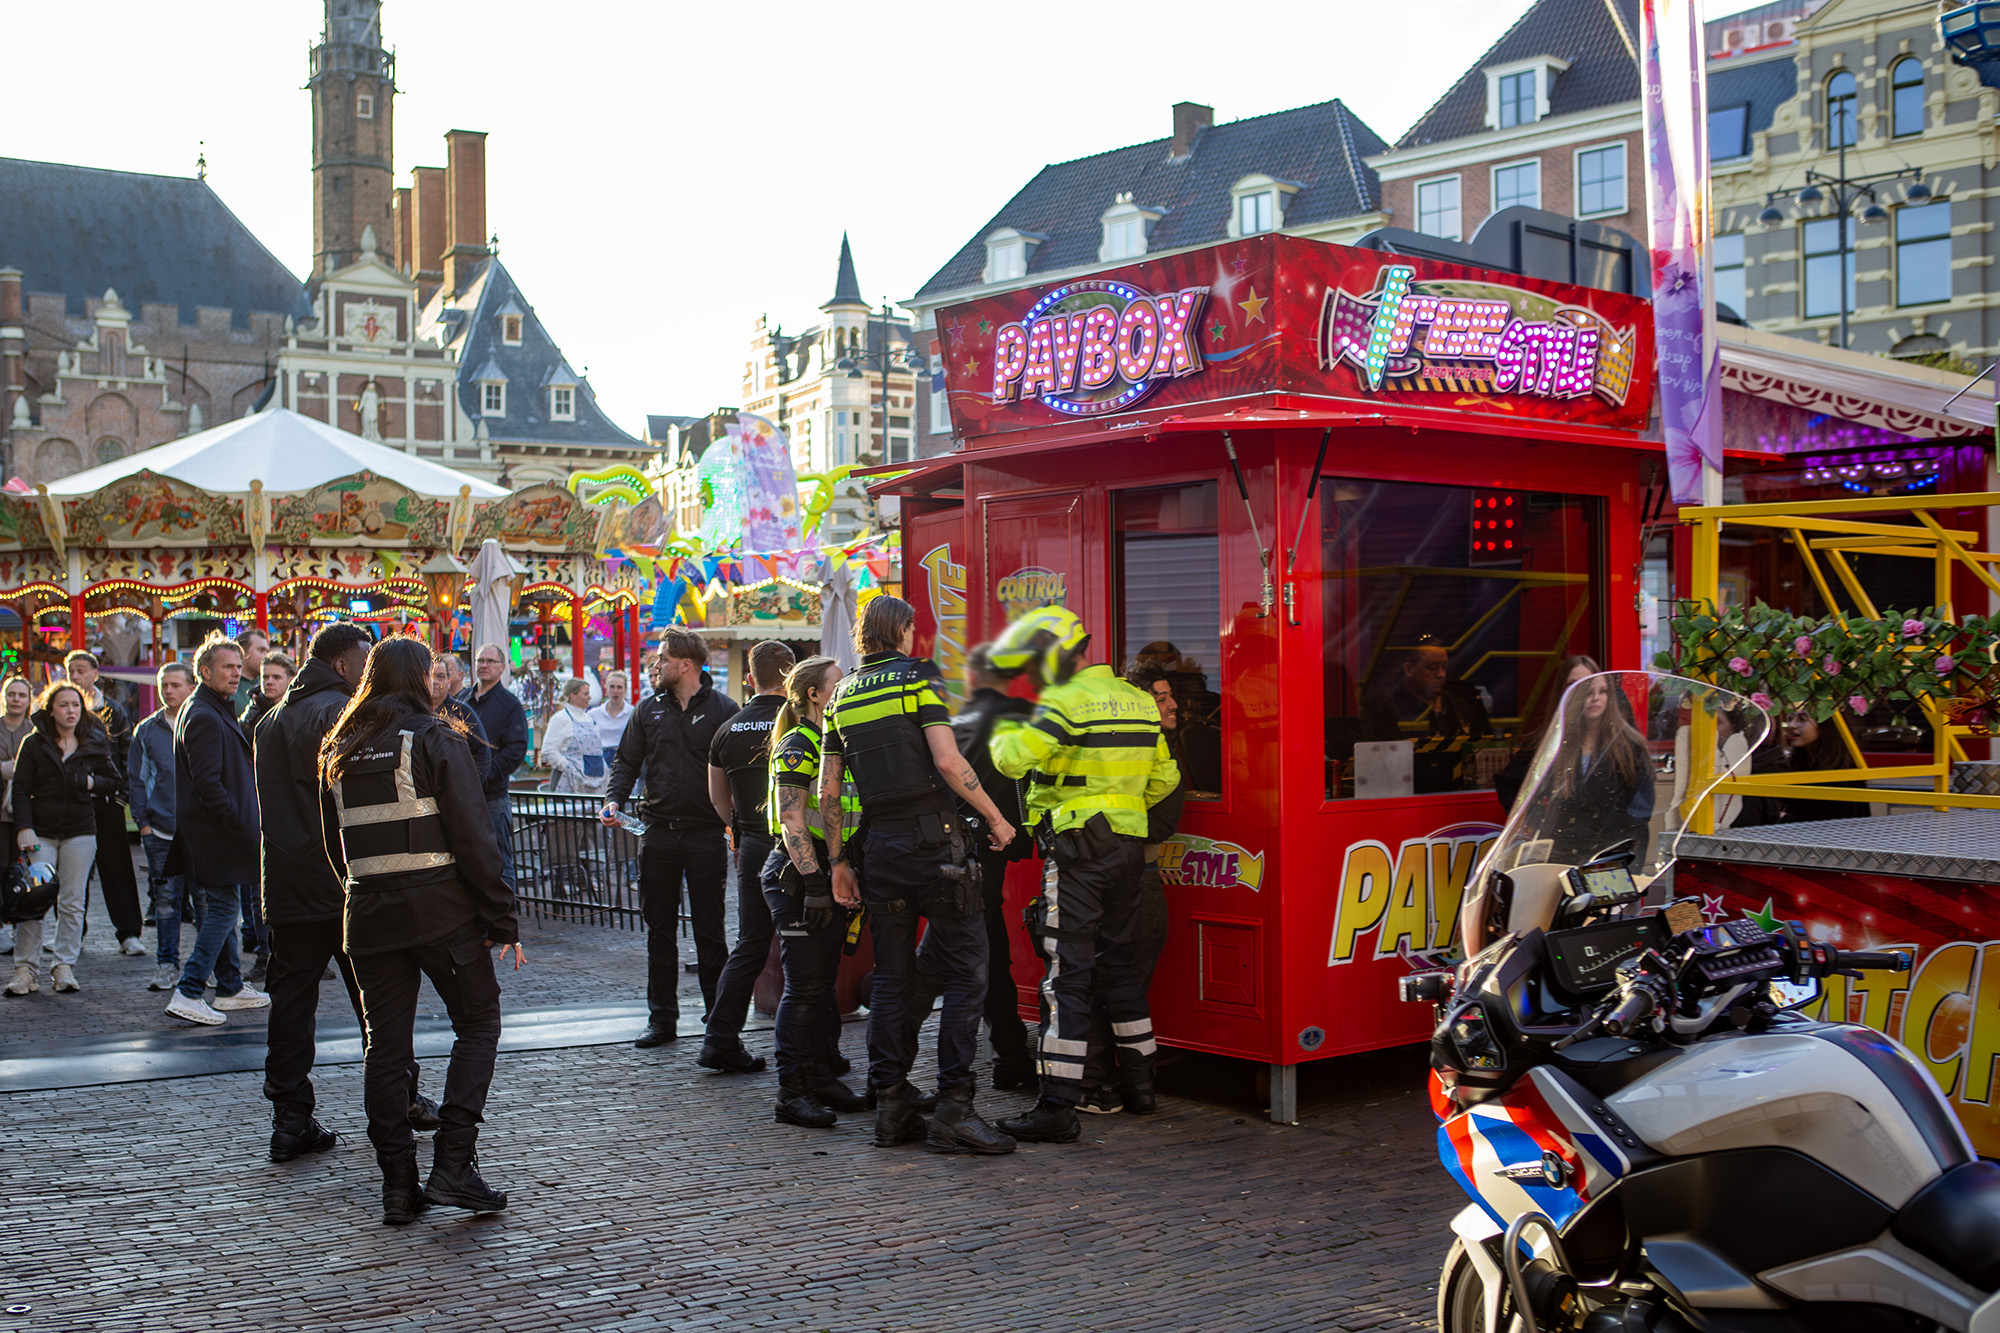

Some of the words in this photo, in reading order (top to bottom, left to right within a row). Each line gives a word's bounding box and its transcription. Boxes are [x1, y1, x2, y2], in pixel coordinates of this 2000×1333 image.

[993, 284, 1210, 405] PAYBOX
[1495, 317, 1600, 398] STYLE
[1423, 366, 1453, 379] ENJOY
[1454, 367, 1471, 380] THE
[1470, 369, 1492, 381] RIDE
[997, 573, 1067, 602] CONTROL
[939, 557, 967, 681] WAVE
[845, 672, 896, 696] OLITIE
[731, 721, 775, 732] SECURIT
[1180, 850, 1240, 888] STYLE
[1328, 833, 1500, 967] PAY
